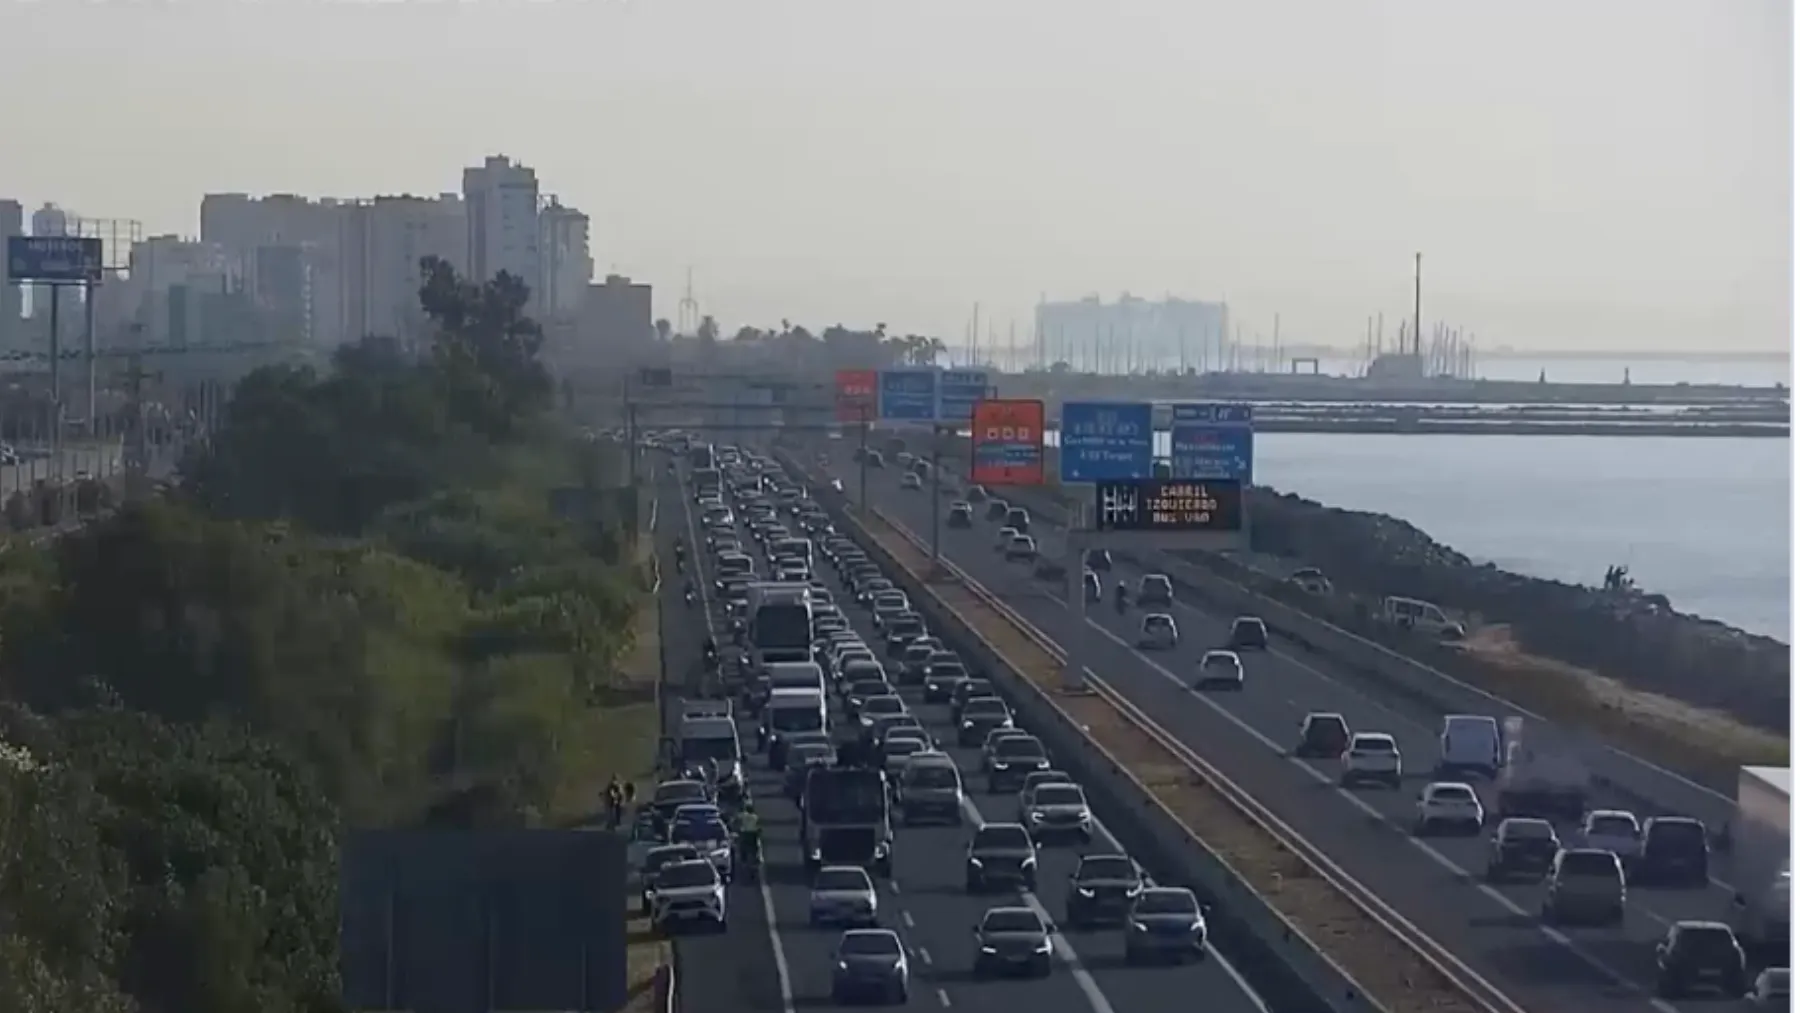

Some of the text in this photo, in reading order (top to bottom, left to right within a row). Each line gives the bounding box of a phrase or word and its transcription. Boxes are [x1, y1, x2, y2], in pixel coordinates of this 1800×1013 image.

[1160, 484, 1208, 497] CARRIL
[1146, 498, 1218, 510] IZQUIERDO
[1152, 512, 1177, 523] BUS
